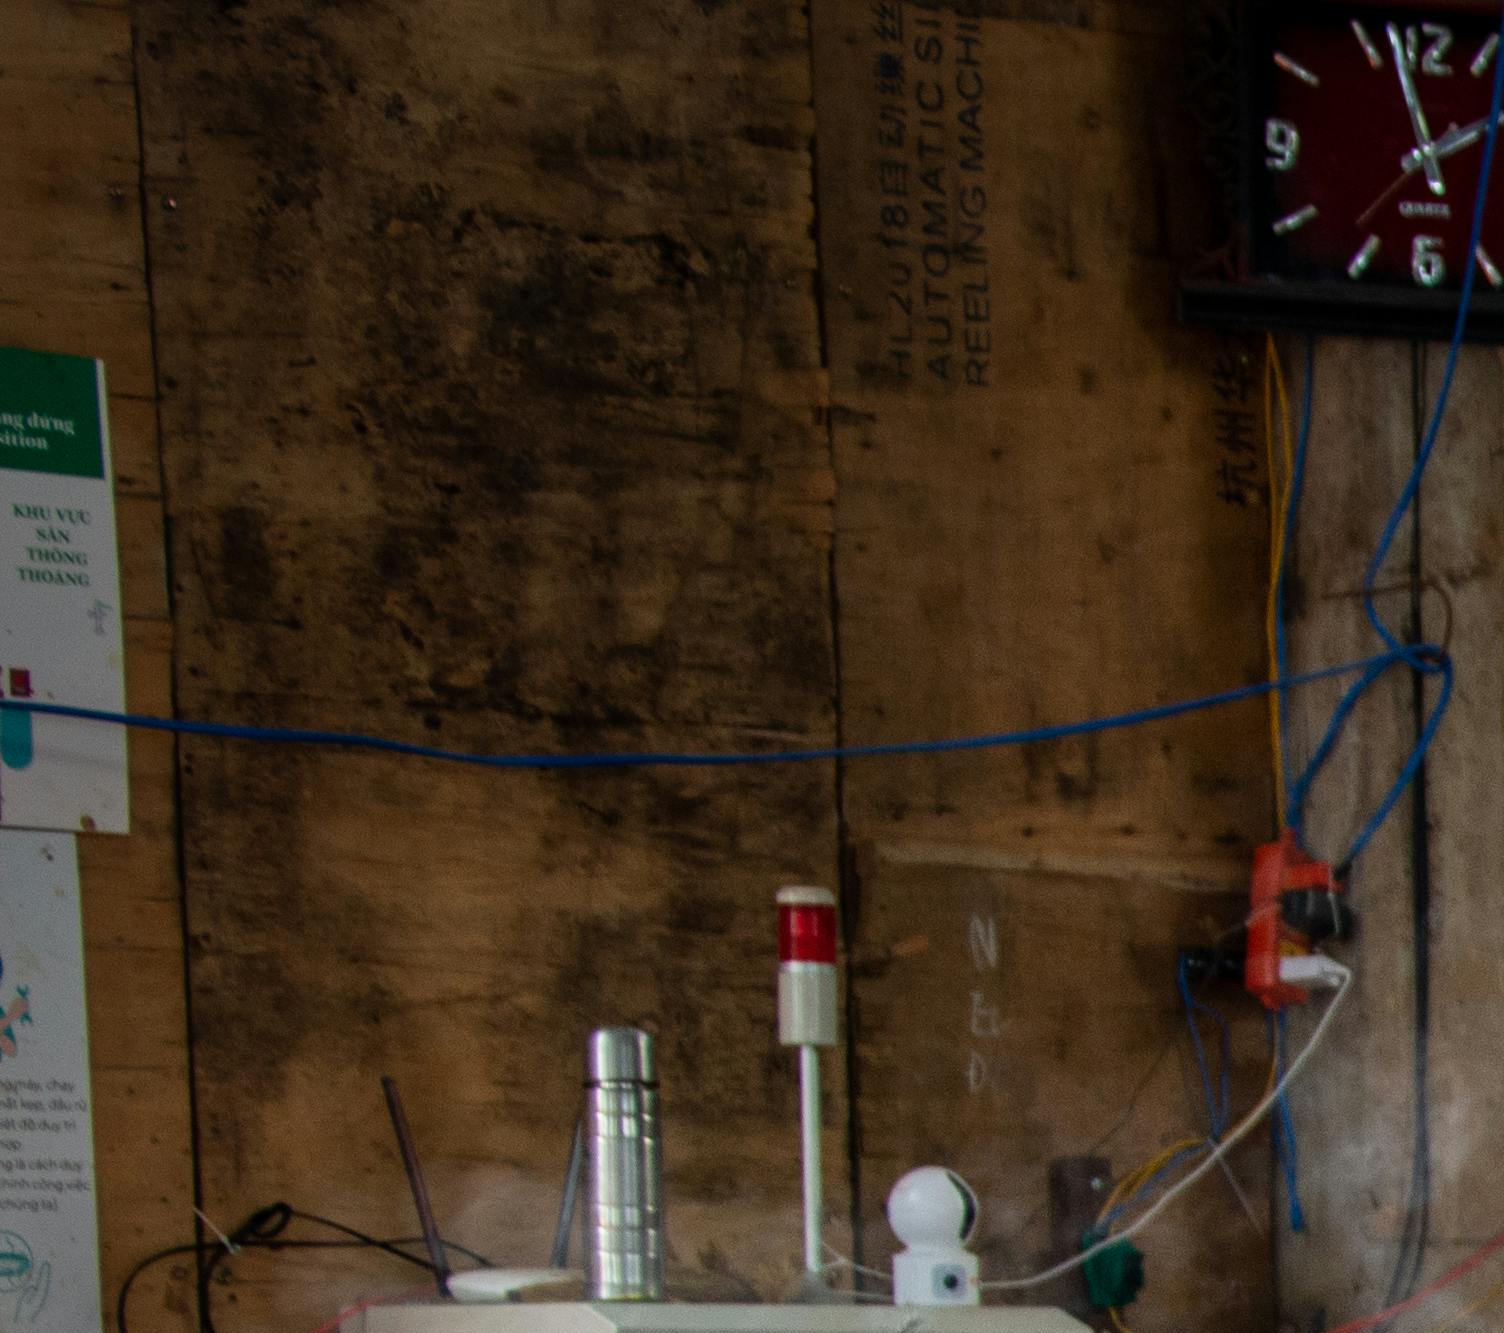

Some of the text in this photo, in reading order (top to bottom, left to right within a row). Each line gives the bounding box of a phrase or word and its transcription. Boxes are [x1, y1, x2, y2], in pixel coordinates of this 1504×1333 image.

[1404, 20, 1455, 78] 12
[1263, 117, 1301, 173] 9
[953, 10, 992, 388] REELING MACHI
[914, 79, 952, 382] AUTOMATIC
[1411, 233, 1446, 289] 6
[12, 502, 51, 521] KHU
